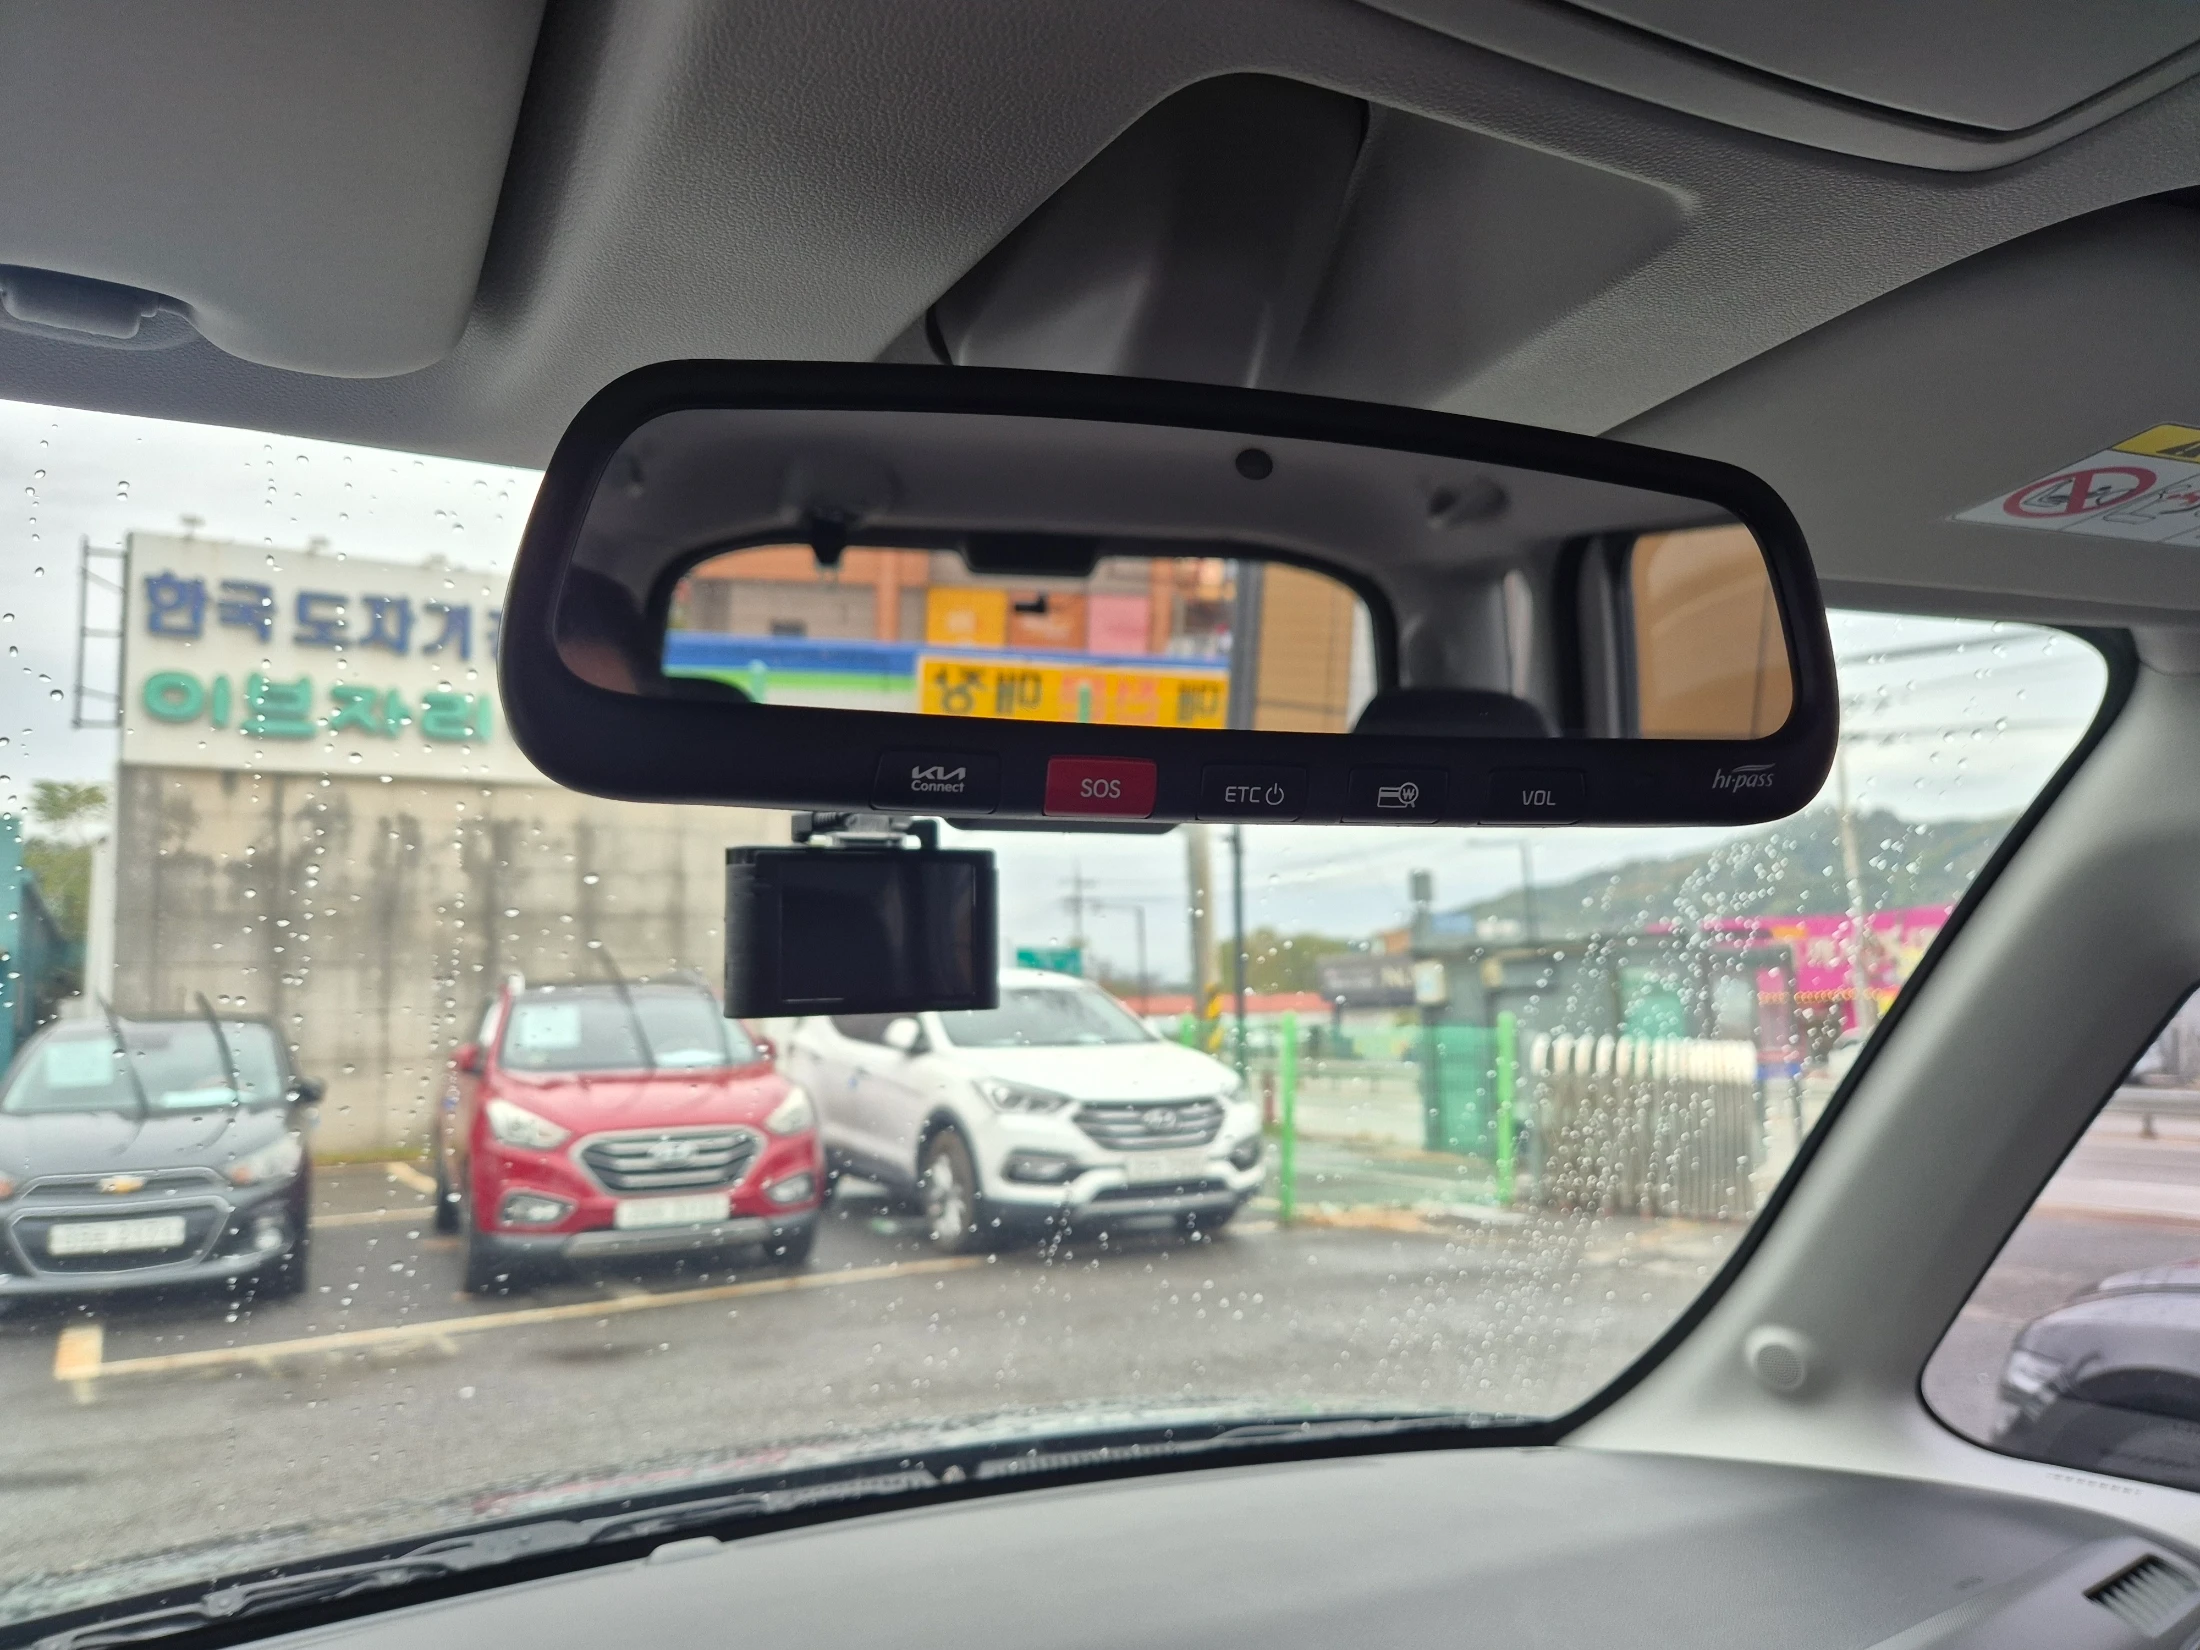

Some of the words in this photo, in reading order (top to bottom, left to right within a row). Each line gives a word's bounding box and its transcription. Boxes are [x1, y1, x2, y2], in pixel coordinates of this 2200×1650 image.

[144, 570, 500, 661] 한국도자기
[144, 672, 493, 740] 이브자리
[911, 765, 966, 781] KIA
[910, 779, 965, 794] Connect
[1080, 778, 1121, 799] SOS
[1224, 785, 1262, 803] ETC
[1523, 790, 1556, 806] VOL
